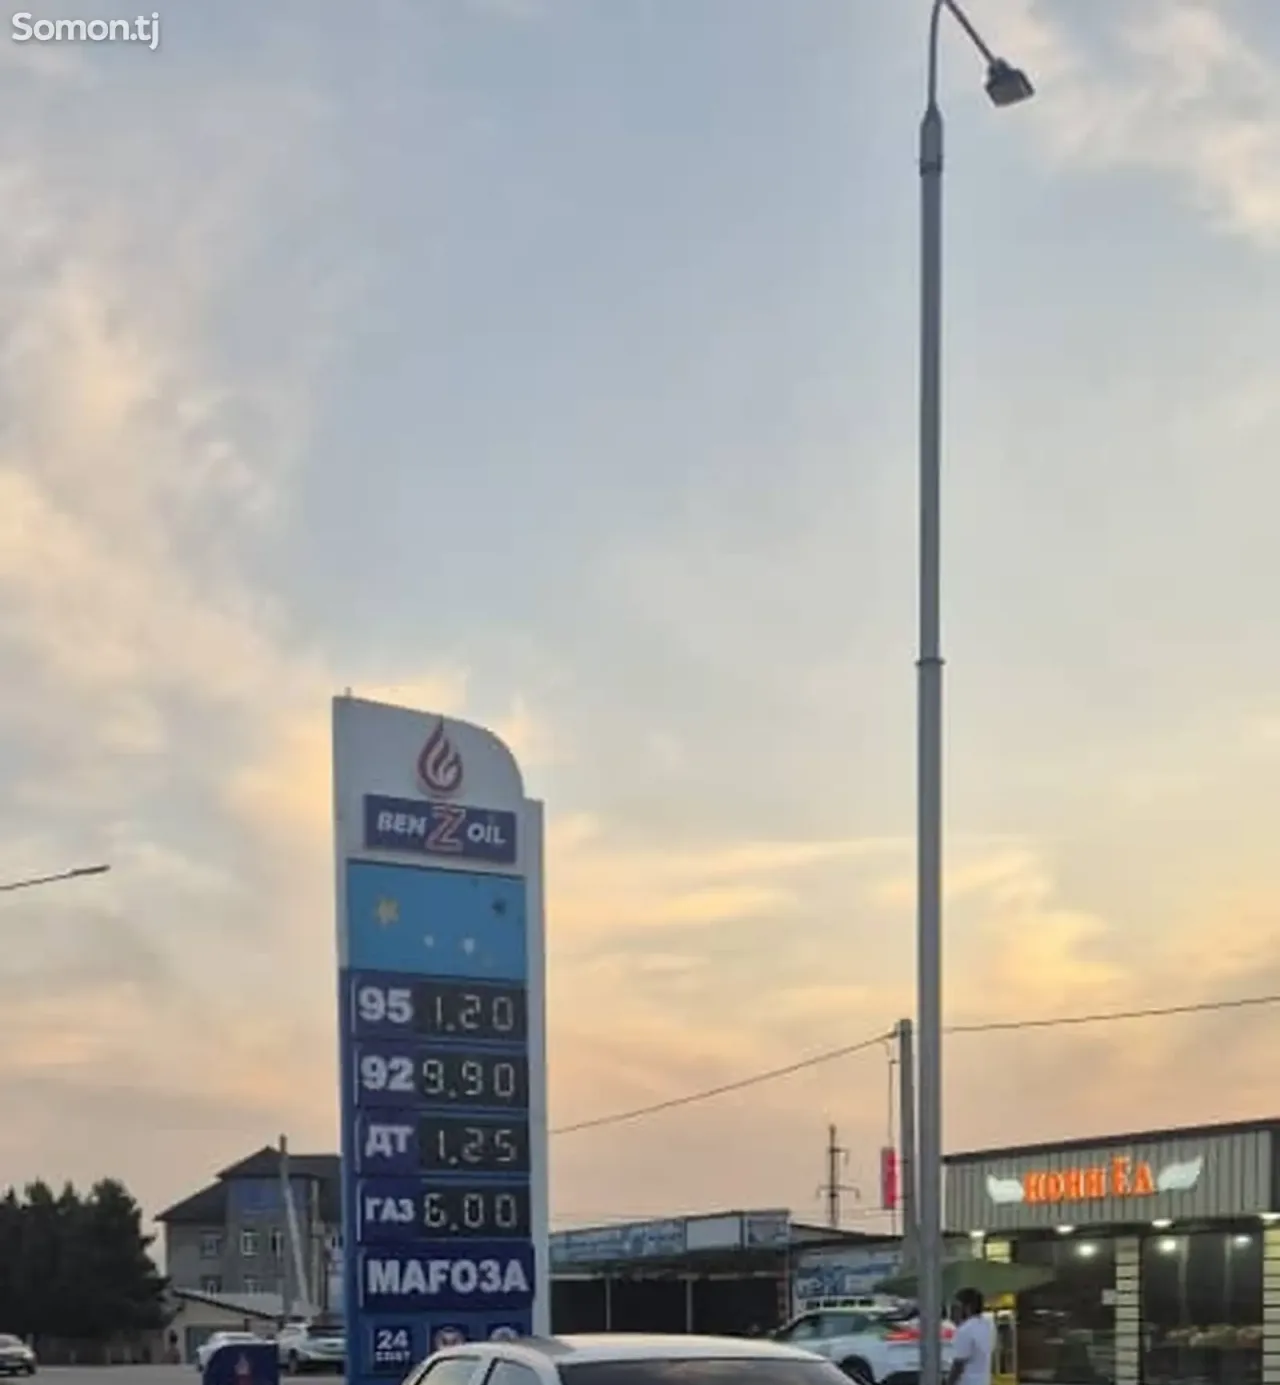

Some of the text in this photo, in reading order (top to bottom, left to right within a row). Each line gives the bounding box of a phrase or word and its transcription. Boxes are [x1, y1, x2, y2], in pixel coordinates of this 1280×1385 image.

[358, 987, 414, 1024] 95
[360, 1055, 415, 1091] 92
[365, 1124, 415, 1157] ДТ
[365, 1197, 416, 1222] ГАЗ
[377, 1329, 408, 1350] 24
